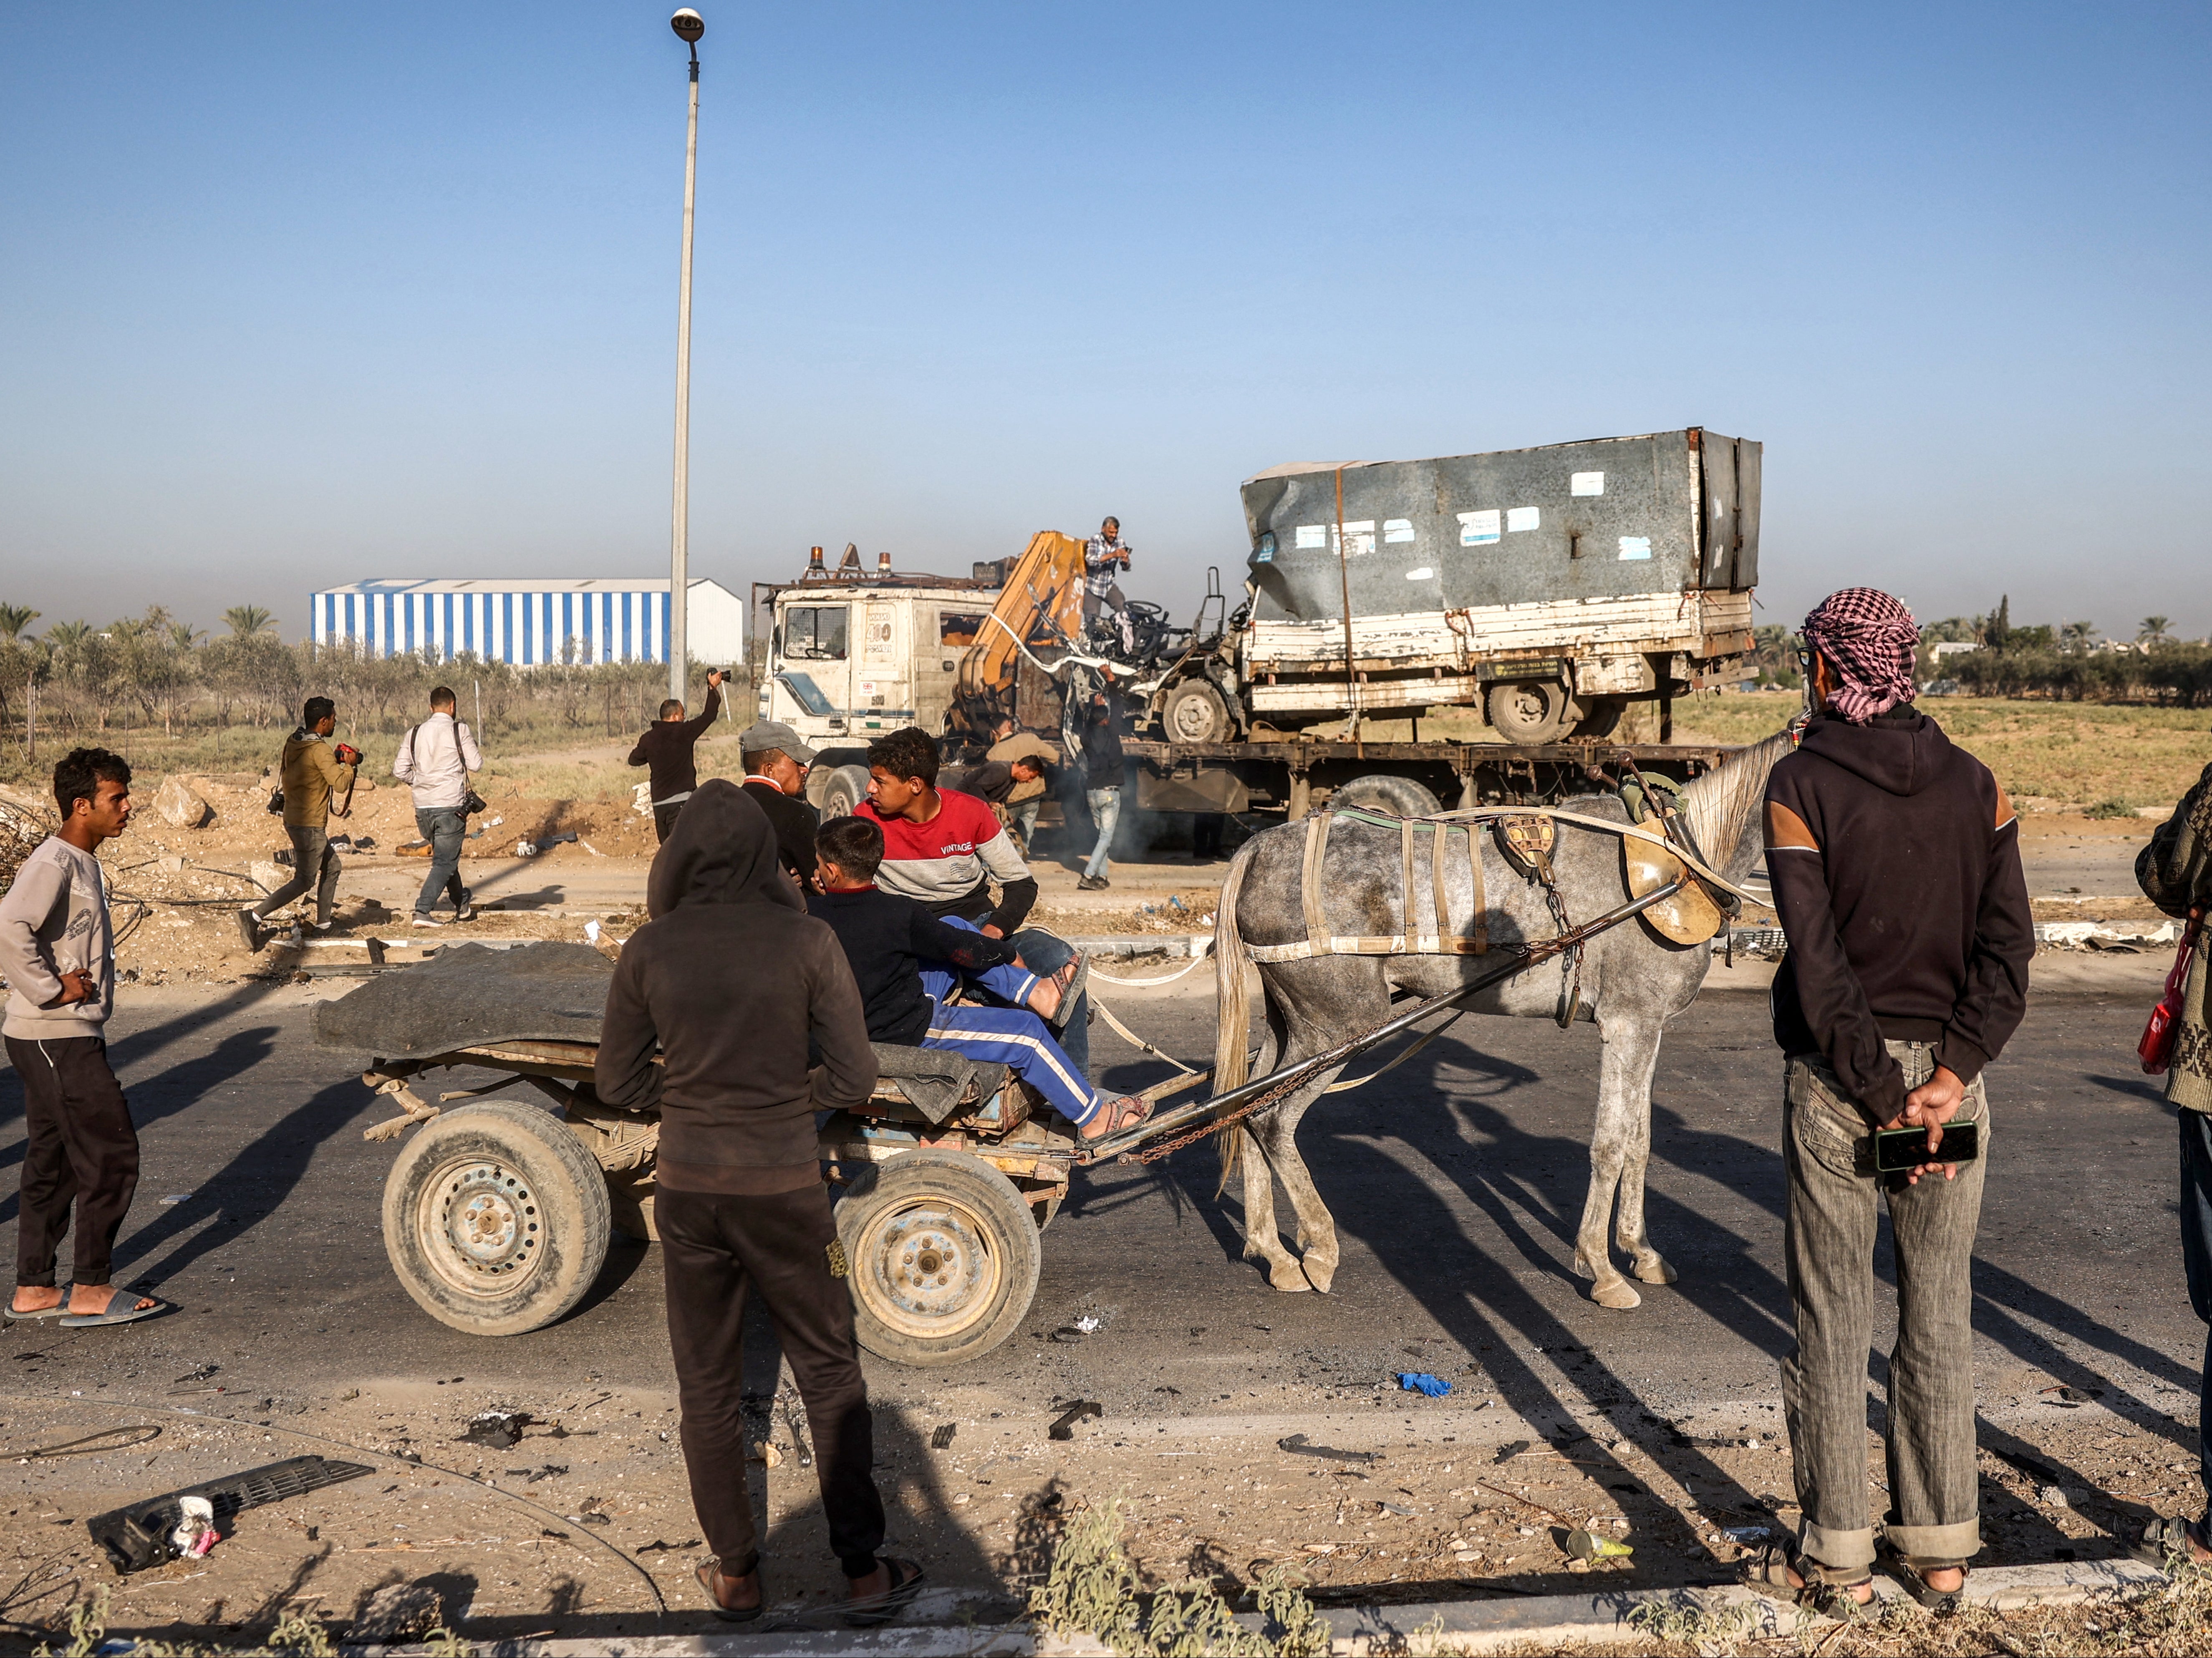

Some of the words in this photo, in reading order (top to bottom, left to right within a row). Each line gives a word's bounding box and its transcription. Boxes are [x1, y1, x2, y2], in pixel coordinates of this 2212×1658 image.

[868, 612, 890, 621] VOLVO
[866, 623, 891, 642] 400
[871, 695, 885, 706] 500
[941, 842, 972, 854] VINTAGE
